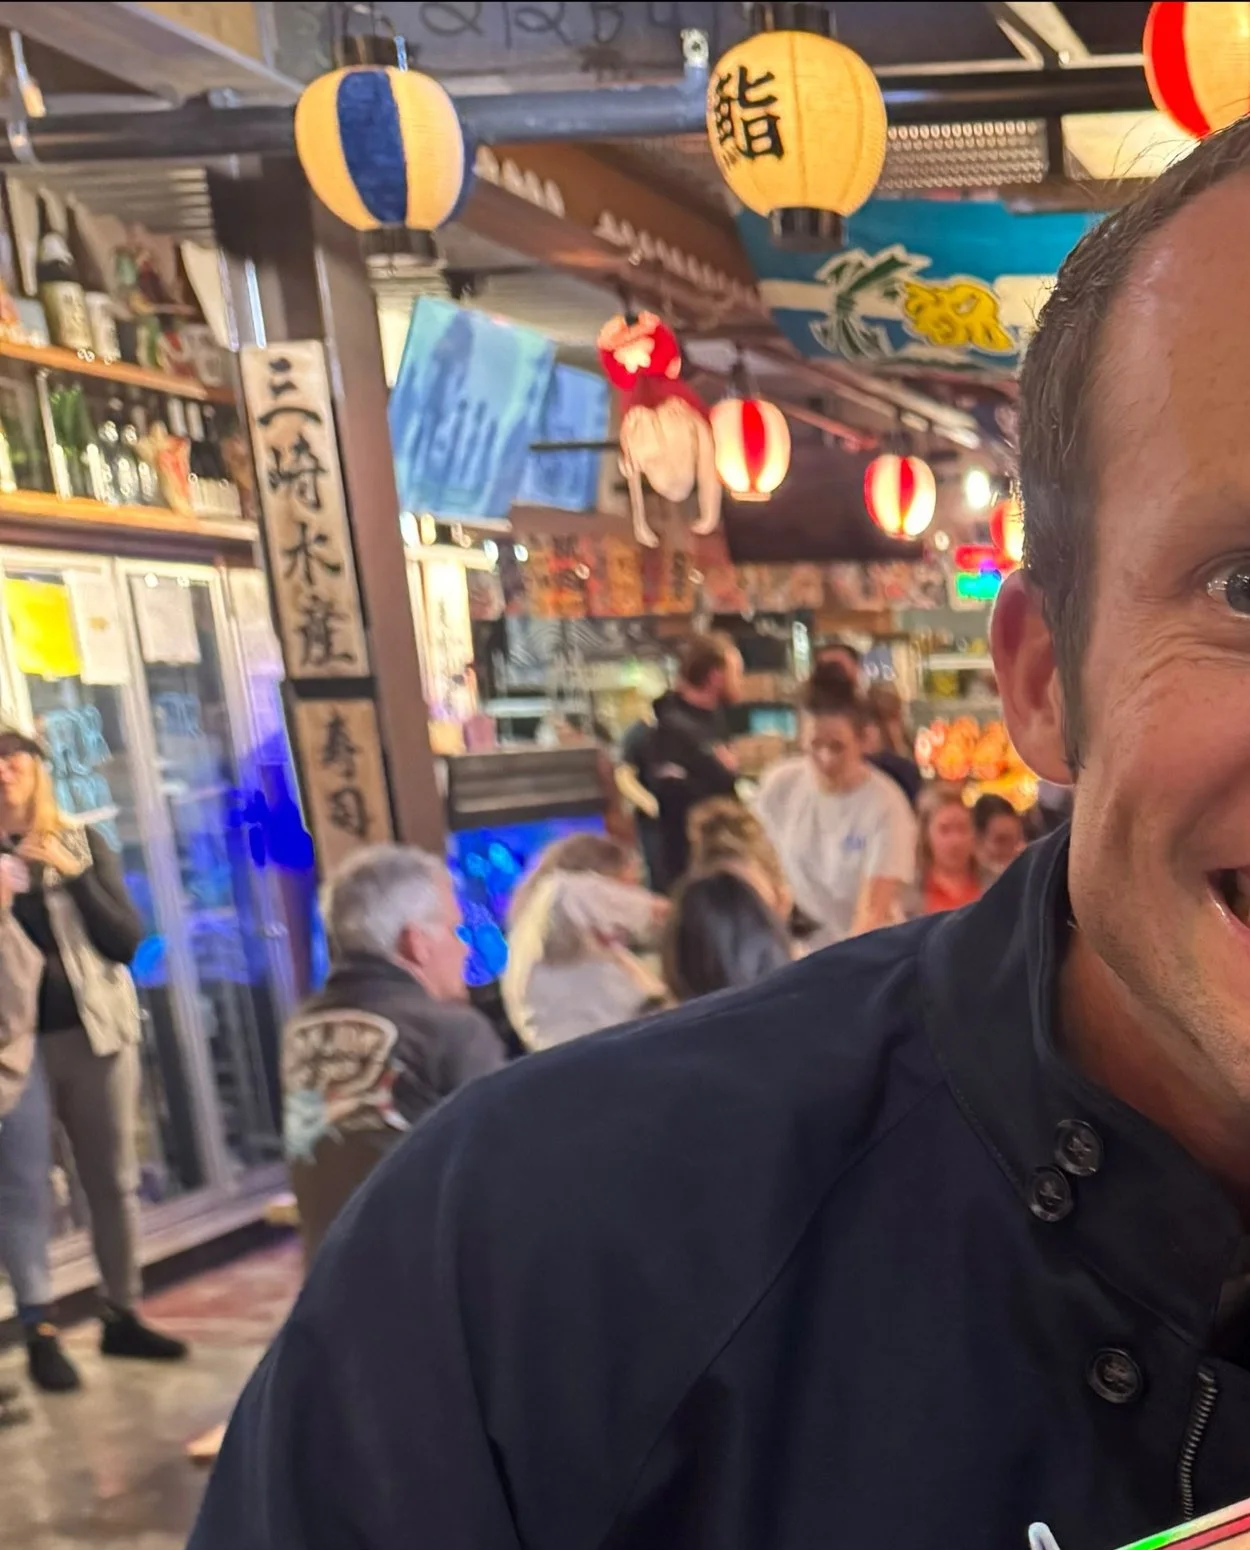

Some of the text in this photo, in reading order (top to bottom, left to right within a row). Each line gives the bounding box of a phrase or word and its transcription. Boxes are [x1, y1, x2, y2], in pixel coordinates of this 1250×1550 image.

[713, 65, 785, 171] 鮨
[257, 356, 358, 666] 三崎水産
